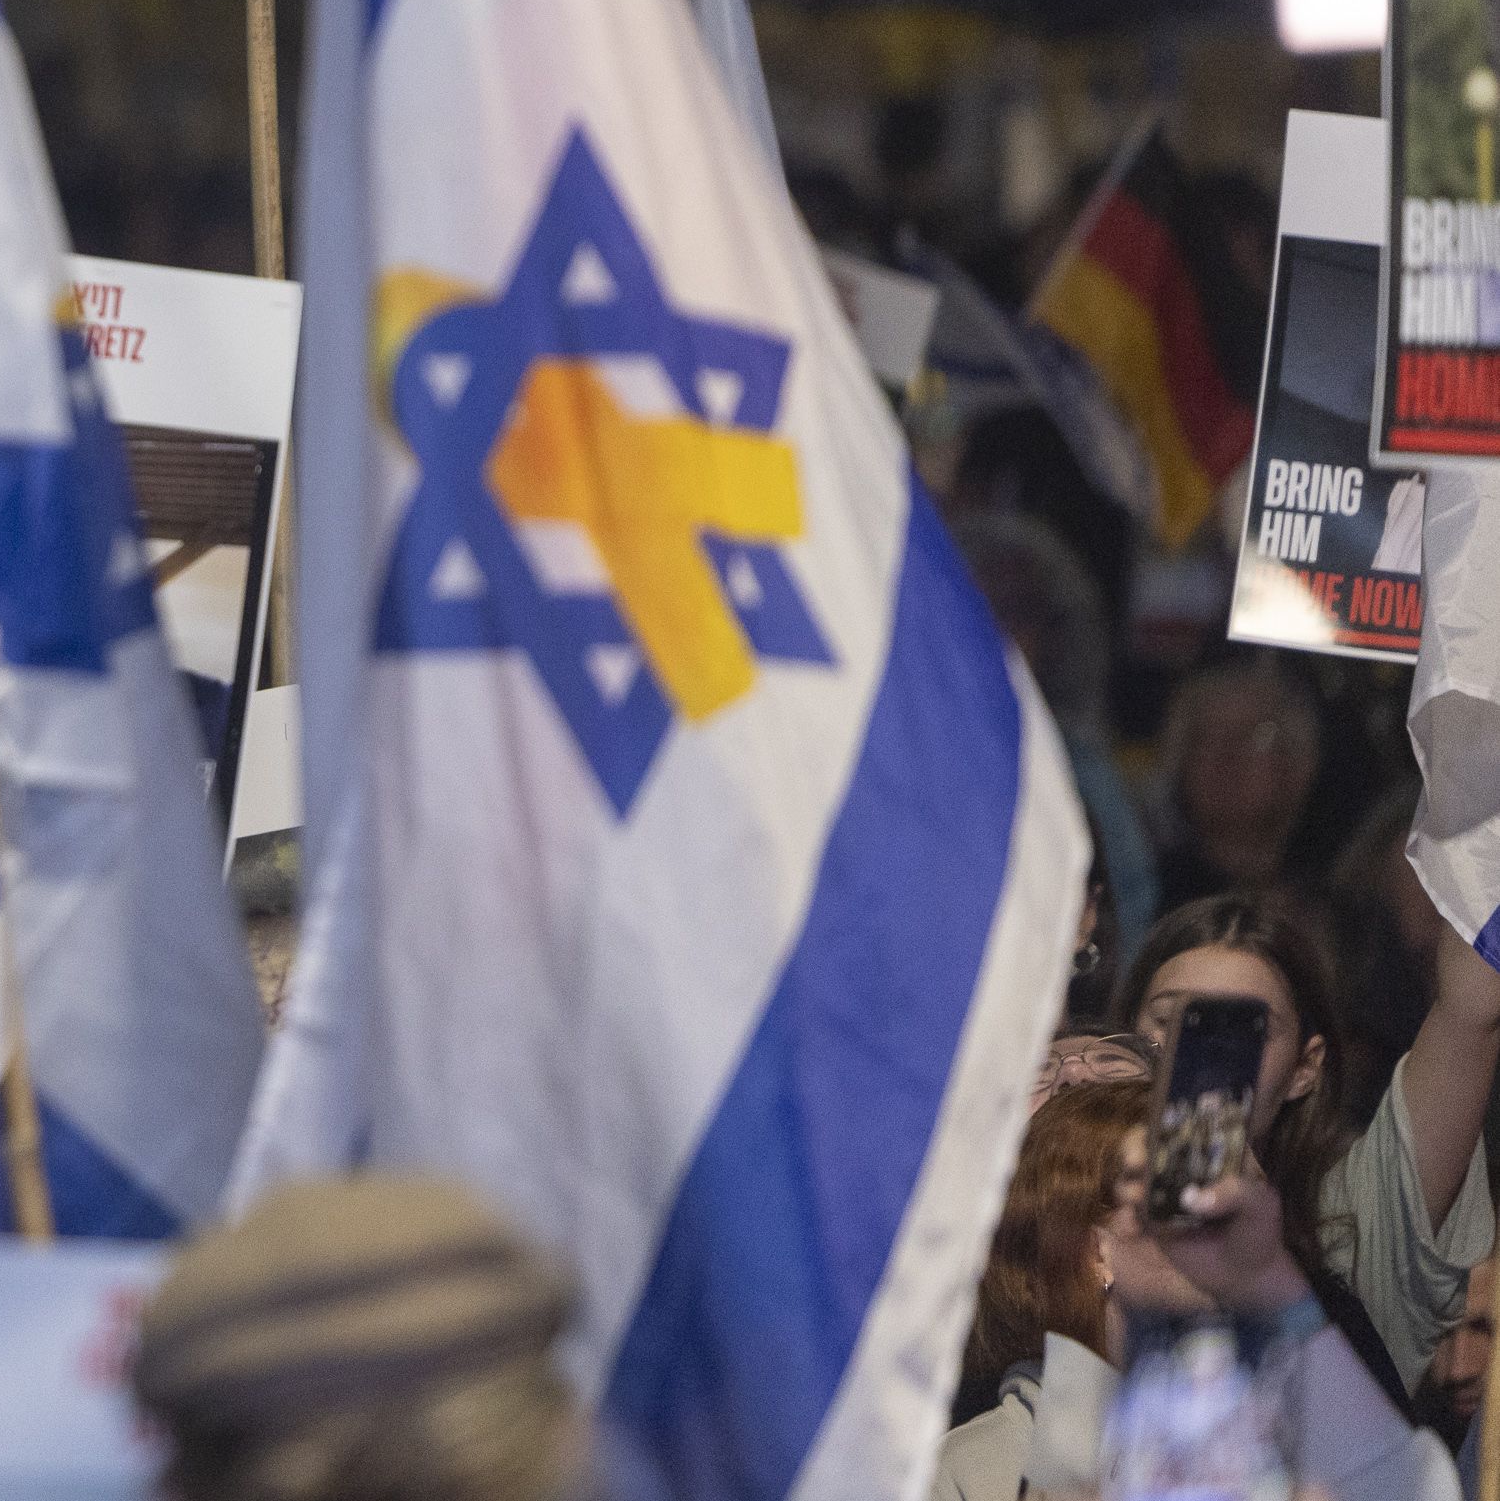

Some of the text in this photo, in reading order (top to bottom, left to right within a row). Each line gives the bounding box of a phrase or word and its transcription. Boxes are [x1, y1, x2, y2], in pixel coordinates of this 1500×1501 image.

[1400, 274, 1478, 344] HIM
[85, 324, 147, 362] RETZ
[1264, 458, 1364, 517] BRING
[1258, 509, 1323, 564] HIM
